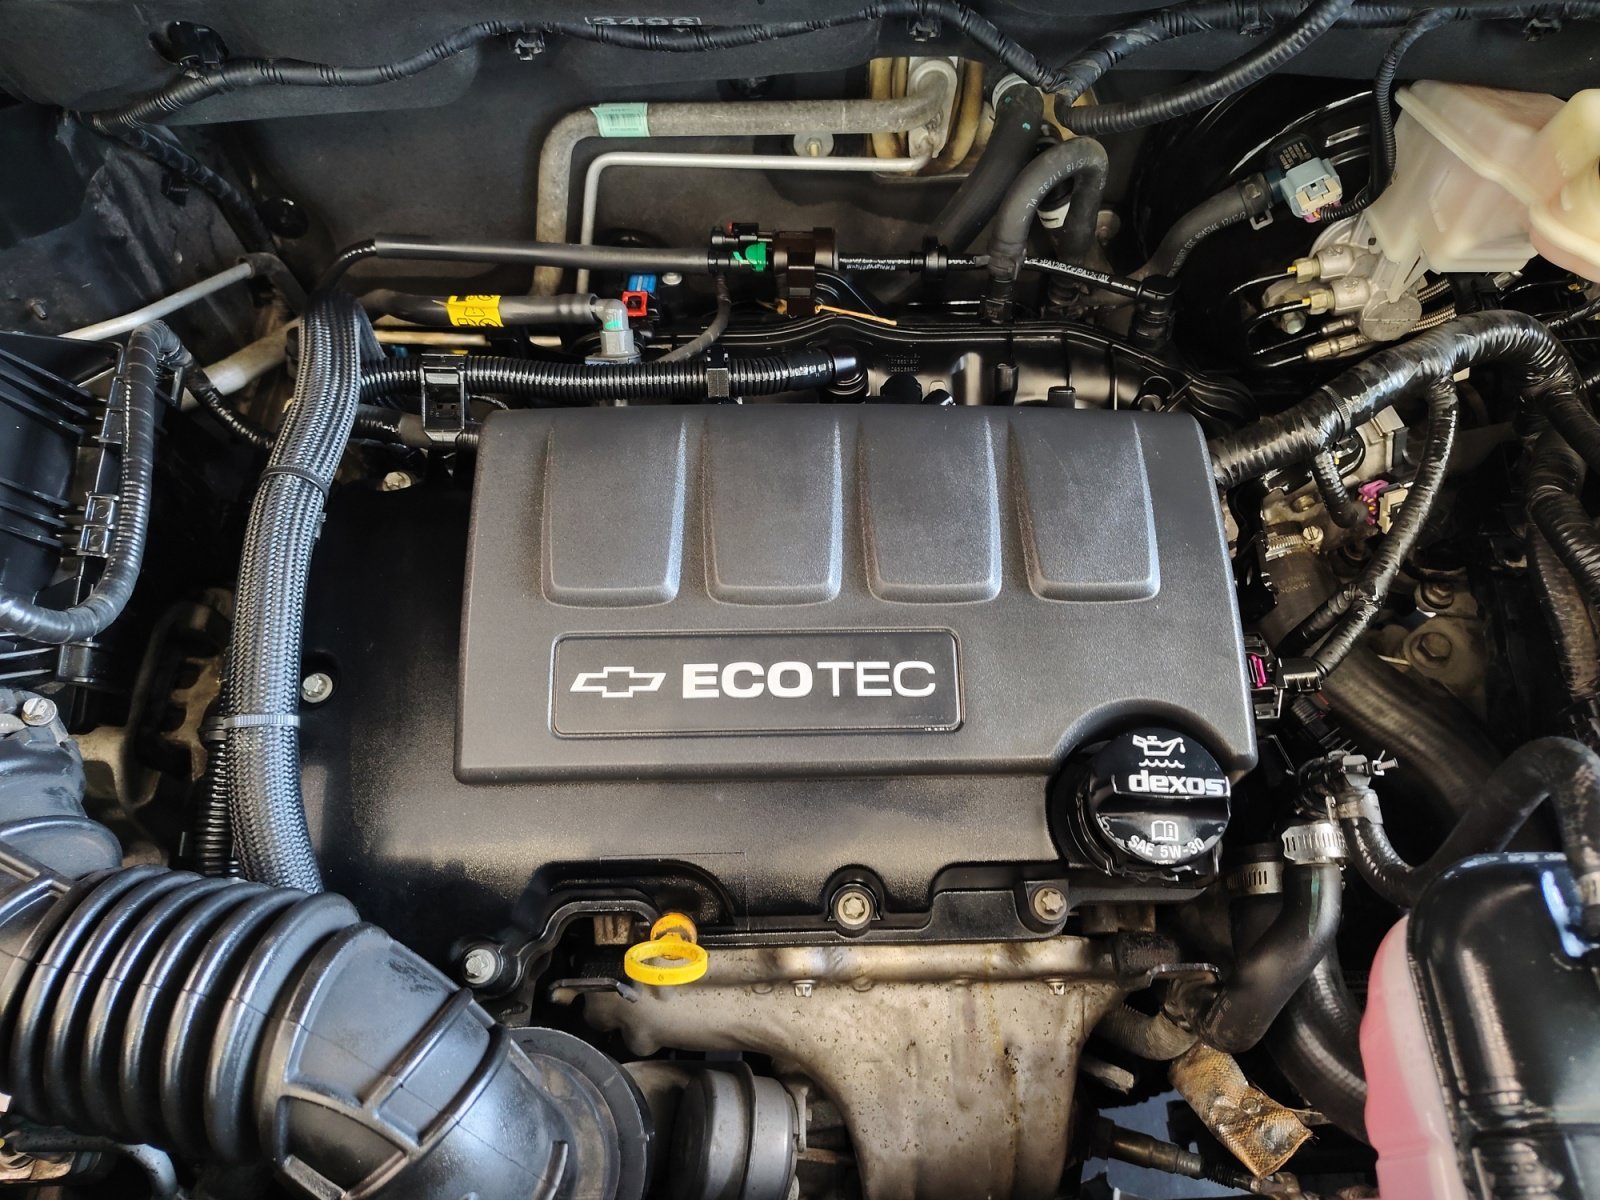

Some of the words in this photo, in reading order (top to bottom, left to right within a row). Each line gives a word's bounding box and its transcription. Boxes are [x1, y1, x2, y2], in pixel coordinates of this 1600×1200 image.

[682, 660, 936, 699] ECOTEC
[1128, 769, 1226, 796] dexos
[1127, 834, 1155, 857] SAE
[1160, 837, 1205, 859] 5W-30
